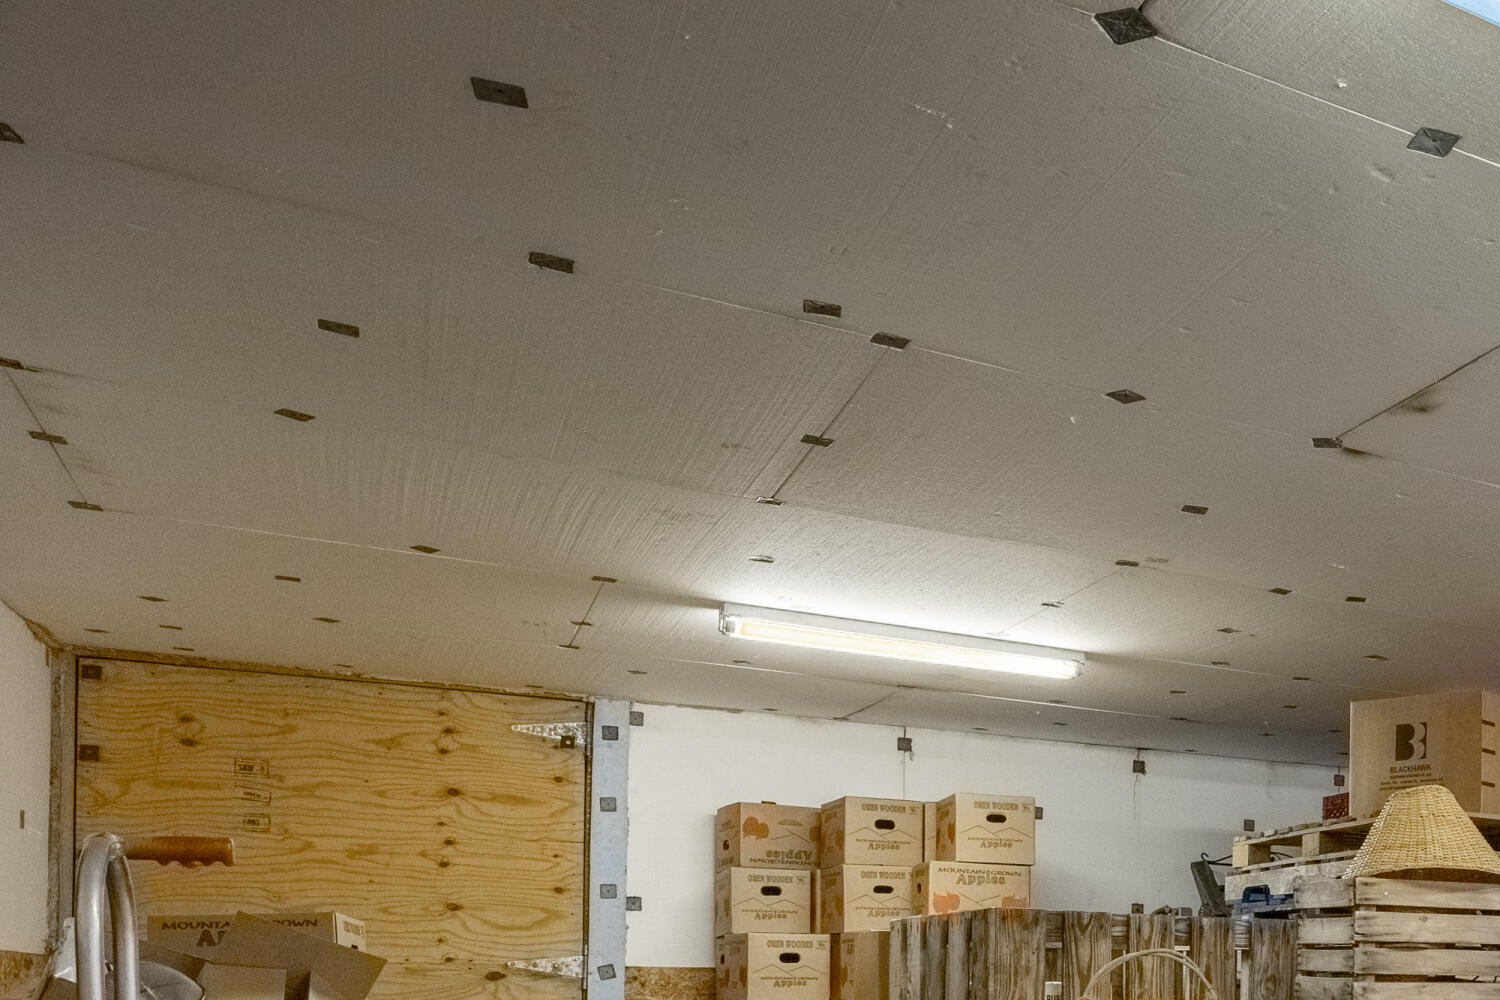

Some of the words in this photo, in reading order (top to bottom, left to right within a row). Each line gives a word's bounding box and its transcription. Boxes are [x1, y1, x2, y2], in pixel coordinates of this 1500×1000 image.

[1390, 764, 1432, 774] BLACKHAWK
[938, 867, 986, 876] MOUNTAIN
[991, 870, 1021, 878] GROWN
[956, 870, 1005, 886] Apples
[161, 920, 231, 930] MOUNTA
[272, 919, 318, 928] OWN
